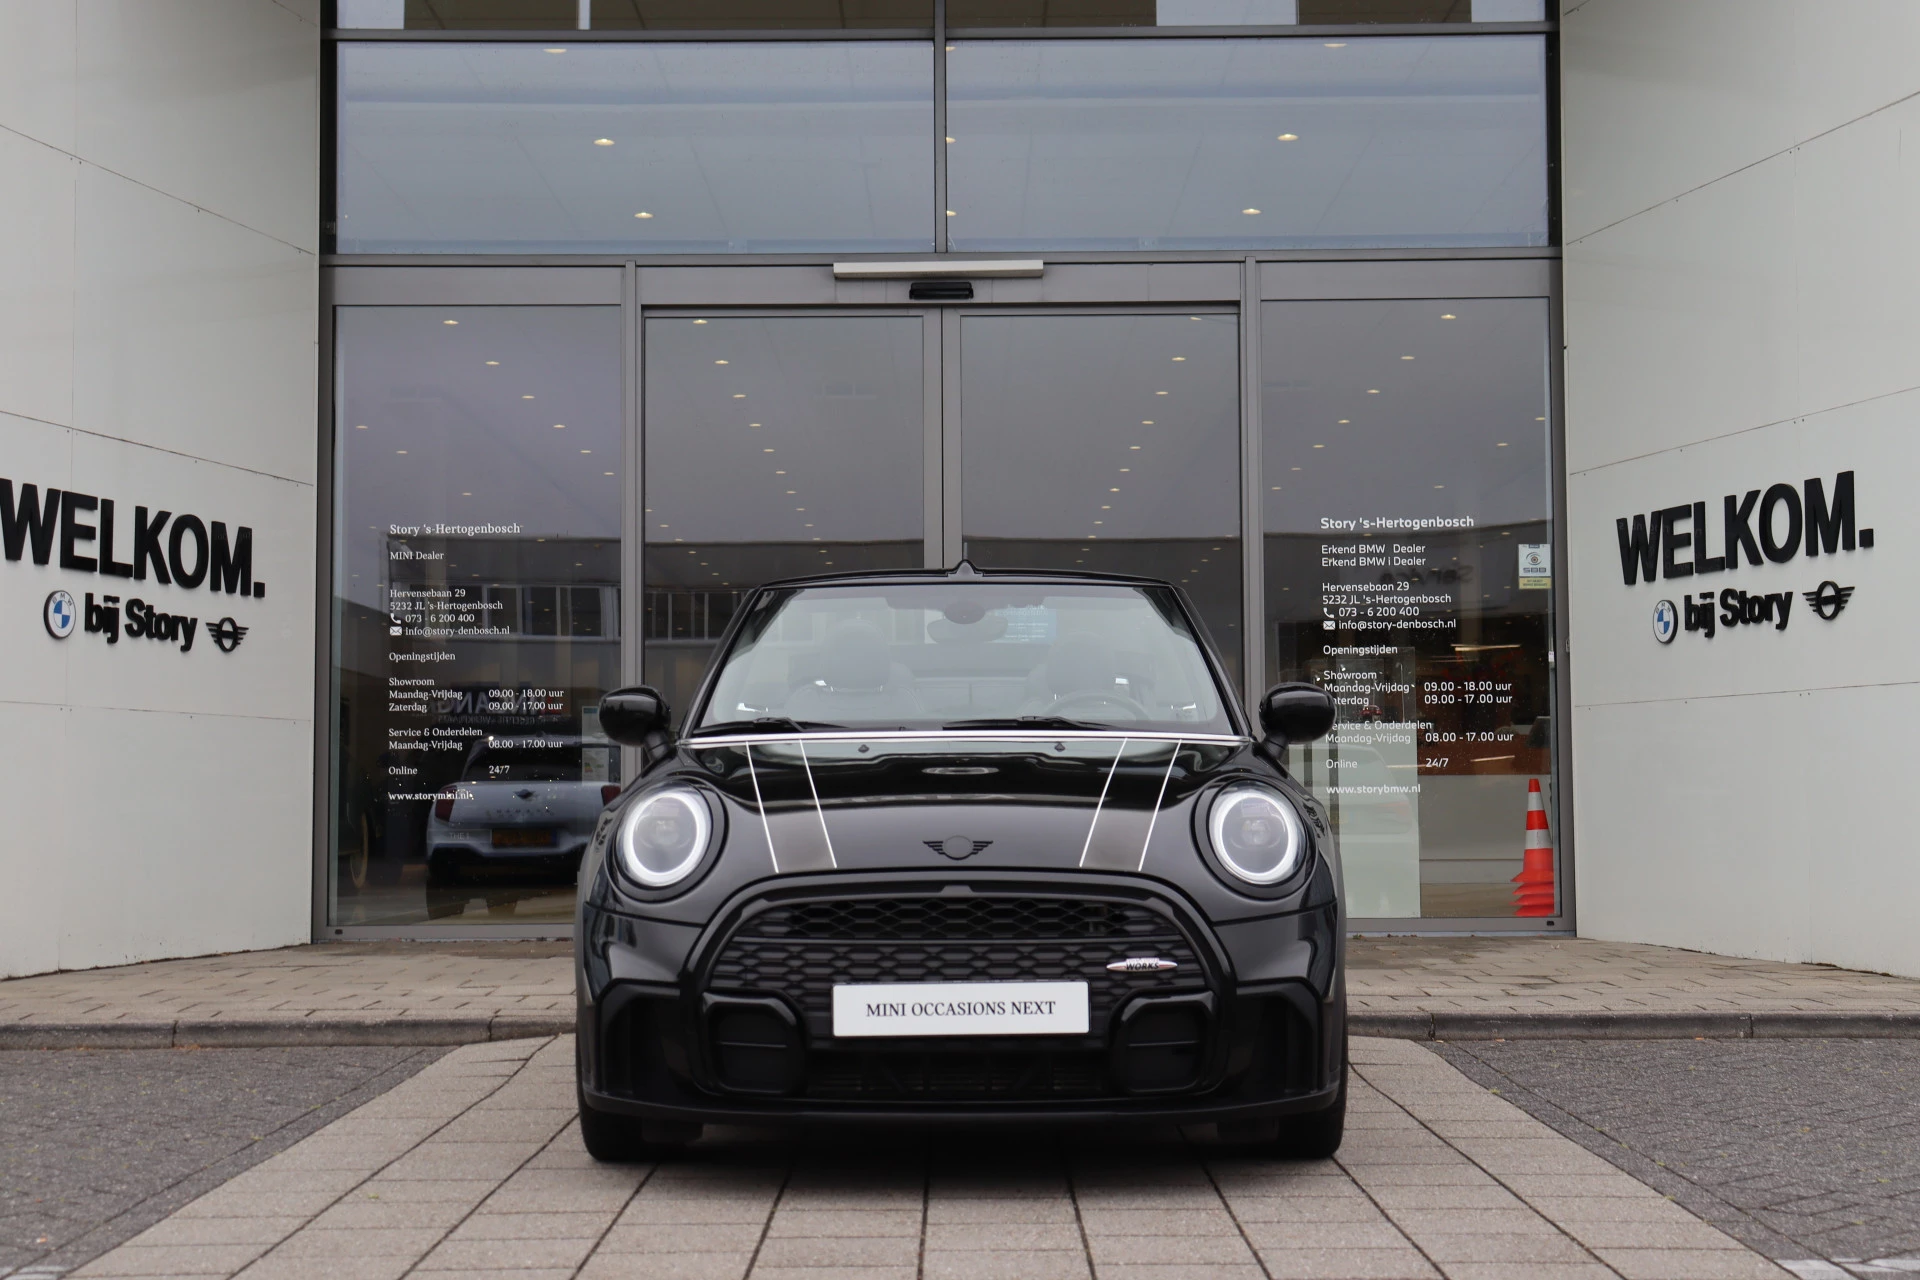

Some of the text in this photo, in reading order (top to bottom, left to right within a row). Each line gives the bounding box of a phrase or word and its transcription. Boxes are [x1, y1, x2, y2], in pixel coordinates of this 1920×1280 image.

[1320, 516, 1474, 530] Story 's-Hertogenbosch
[1616, 470, 1874, 585] WELKOM.
[390, 524, 419, 536] Story
[0, 478, 265, 598] WELKOM.
[1322, 544, 1425, 554] Erkend BMW Dealer
[390, 552, 444, 560] MINI Dealer
[1322, 558, 1356, 567] Erkend
[1359, 558, 1385, 566] BMW
[1393, 557, 1426, 566] Dealer
[1322, 582, 1409, 592] Hervensebaan 29
[390, 588, 466, 598] Hervensebaan 29
[1322, 594, 1451, 605] 5232 JL 's-Hertogenbosch
[390, 602, 412, 610] 5232
[415, 602, 425, 610] JL
[1338, 608, 1357, 617] 073
[1367, 608, 1374, 616] 6
[1376, 607, 1396, 616] 200
[1399, 607, 1419, 616] 400
[1684, 588, 1793, 638] bij Story
[84, 593, 198, 652] bij Story
[405, 614, 422, 622] 073
[430, 614, 436, 622] 6
[438, 614, 455, 622] 200
[457, 614, 474, 622] 400
[1339, 619, 1456, 631] info@story-denbosch.nl
[405, 626, 510, 636] info@story-denbosch.nl
[1323, 645, 1398, 657] Openingstijden
[389, 652, 456, 662] Openingstijden
[1324, 671, 1377, 680] Showroom
[389, 677, 435, 686] Showroom
[1324, 682, 1409, 694] Maandag-Vrijdag
[1424, 682, 1454, 691] 09.00
[1464, 682, 1492, 691] 18.00
[389, 690, 462, 700] Maandag-Vrijdag
[488, 689, 514, 698] 09.00
[522, 689, 546, 698] 18.00
[1333, 696, 1369, 706] terdag
[1424, 694, 1454, 704] 09.00
[1465, 694, 1492, 703] 17.00
[389, 703, 427, 713] Zaterdag
[488, 702, 514, 710] 09.00
[522, 702, 546, 710] 17.00
[1332, 720, 1432, 730] ervice & Onderdelen
[389, 727, 483, 736] Service & Onderdelen
[1325, 733, 1411, 744] Maandag-Vrijdag
[1425, 732, 1455, 742] 08.00
[1466, 732, 1494, 741] 17.00
[389, 740, 462, 751] Maandag-Vrijdag
[488, 740, 514, 749] 08.00
[522, 740, 546, 748] 17.00
[1326, 758, 1448, 768] Online 24/7
[389, 766, 418, 775] Online
[1326, 784, 1421, 795] www.storybmw.nl
[388, 791, 469, 801] www.storymini.nl
[866, 1000, 1056, 1017] MINI OCCASIONS NEXT
